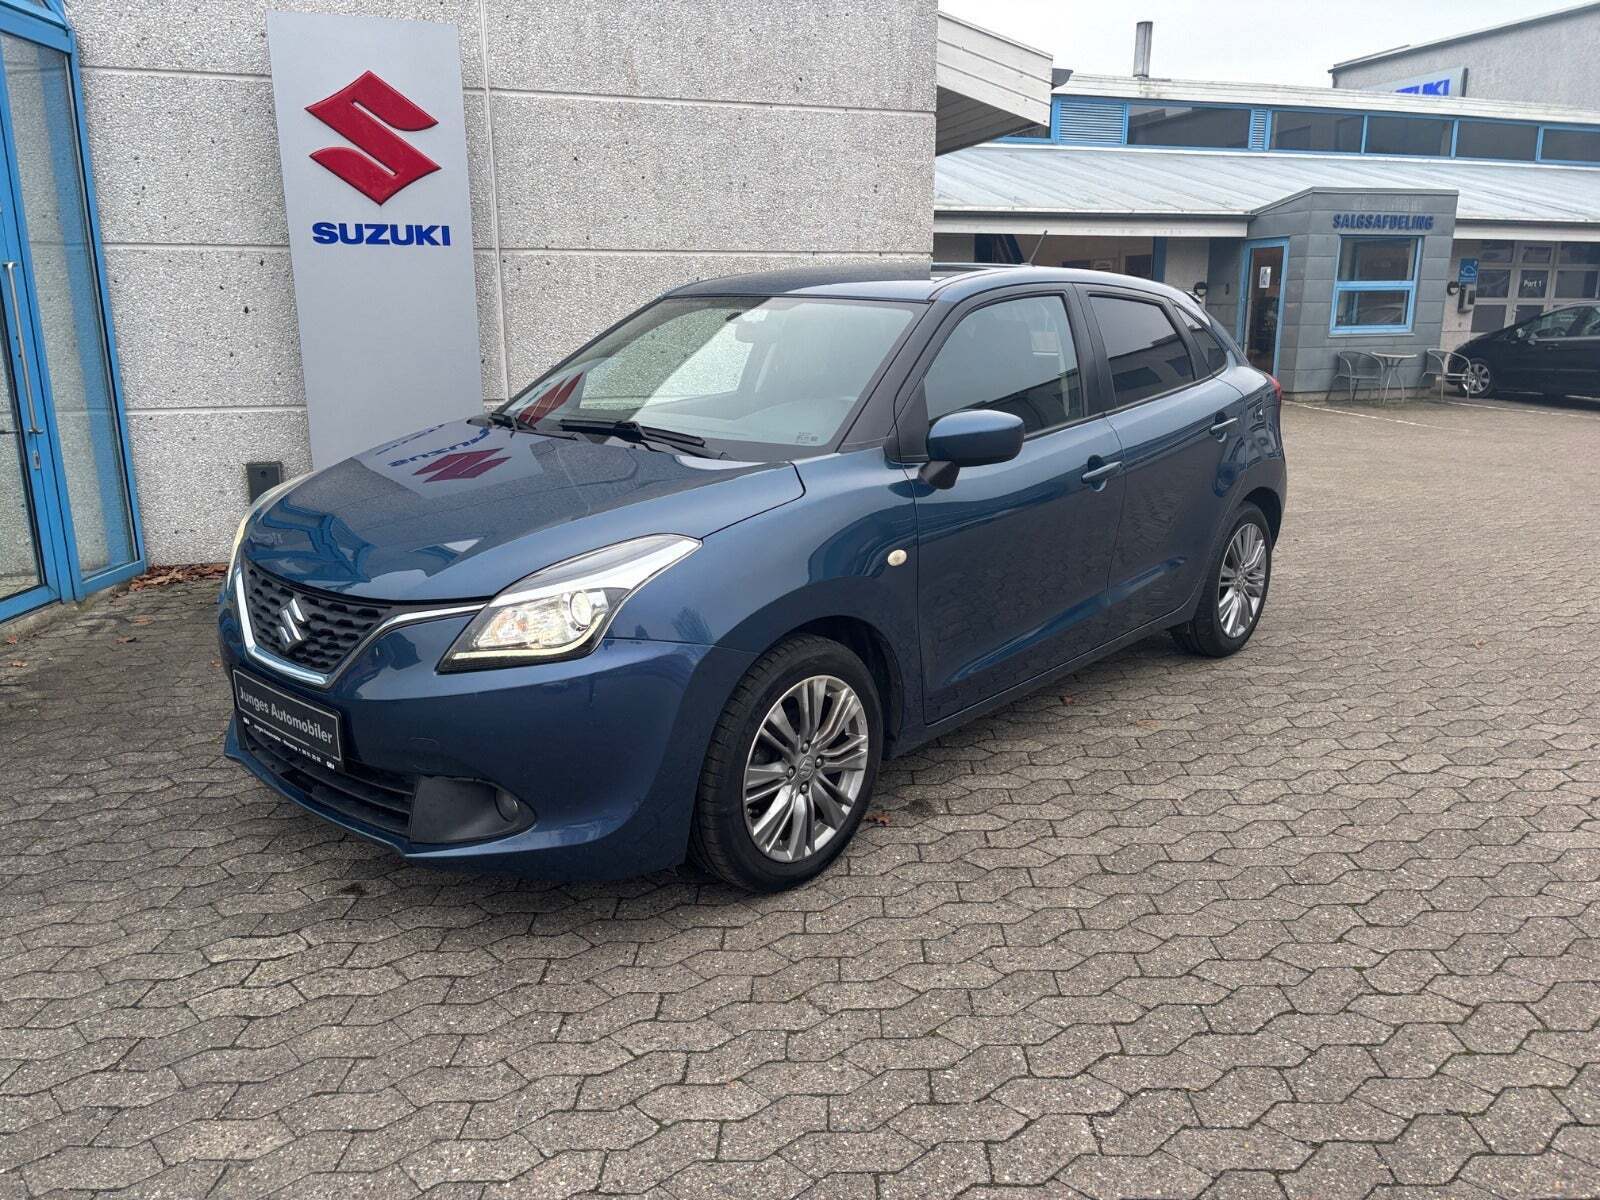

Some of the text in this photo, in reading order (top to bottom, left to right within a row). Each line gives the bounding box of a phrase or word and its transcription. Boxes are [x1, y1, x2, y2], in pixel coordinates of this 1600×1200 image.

[312, 222, 451, 246] SUZUKI
[1333, 214, 1434, 230] SALGSAFDELING
[240, 686, 269, 713] Junges
[271, 703, 333, 743] Automobiler
